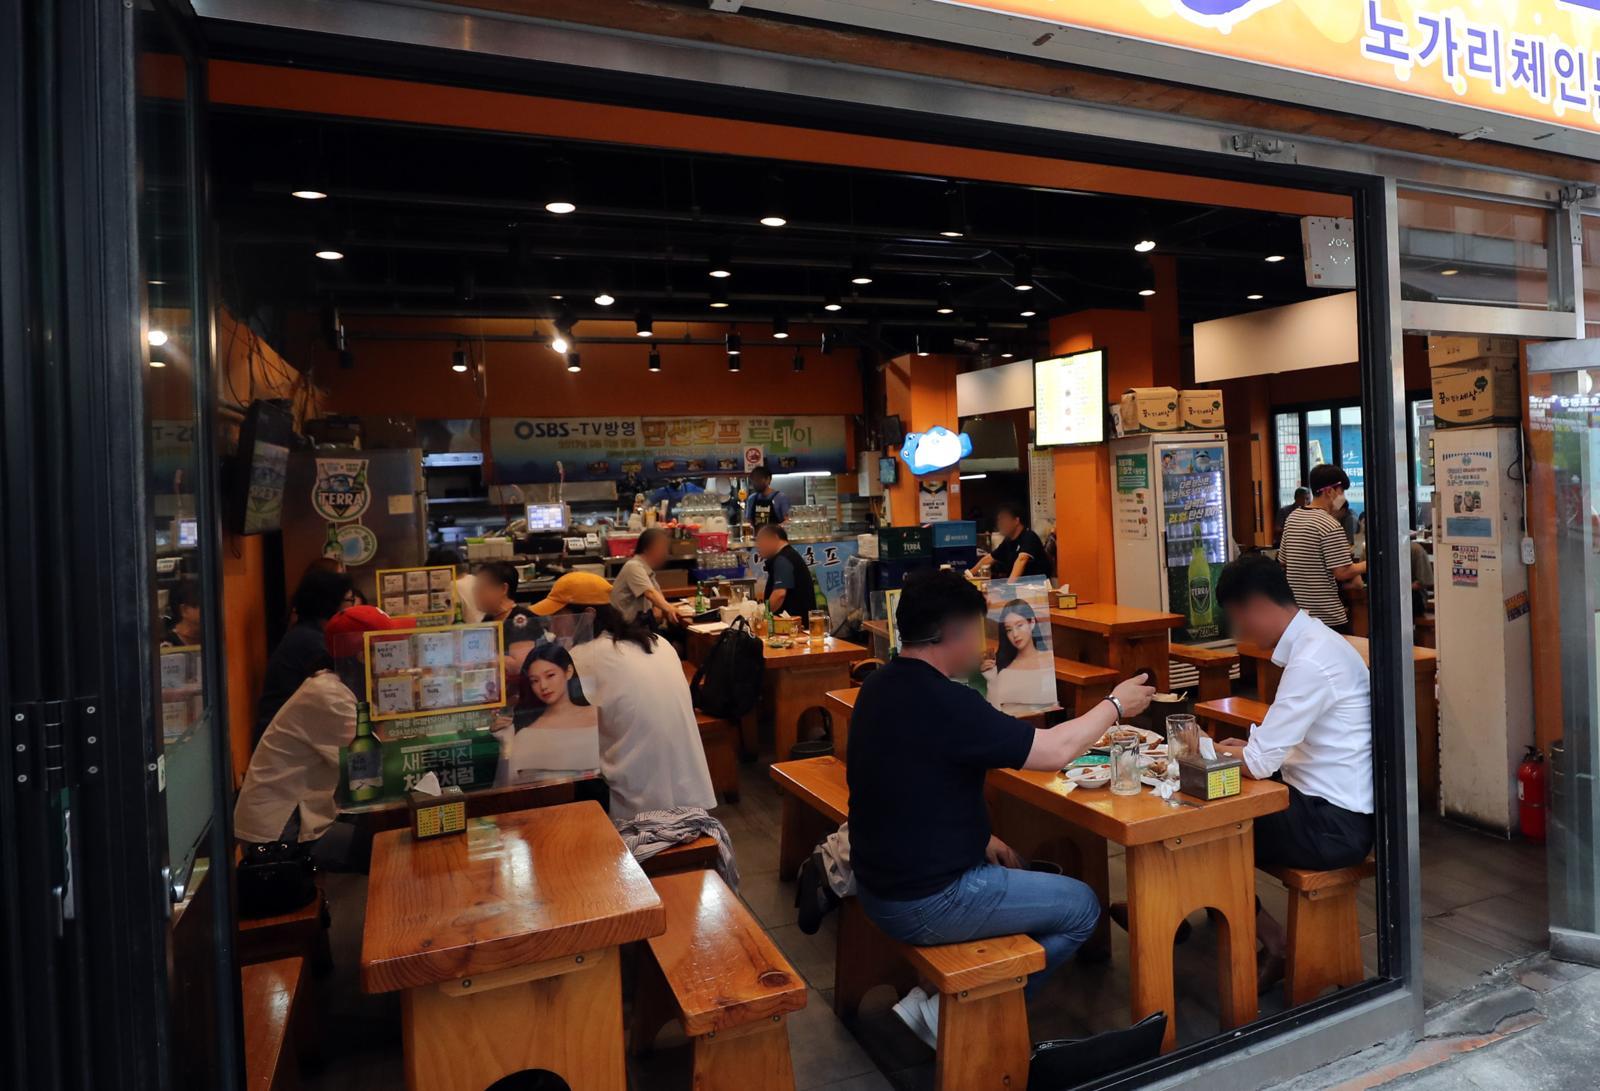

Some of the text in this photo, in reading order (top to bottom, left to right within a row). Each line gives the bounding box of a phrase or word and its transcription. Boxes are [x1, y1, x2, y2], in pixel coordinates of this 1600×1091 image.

[1365, 1, 1600, 105] 노가리체인
[318, 492, 363, 506] TERRA
[903, 542, 921, 552] TERRA
[402, 747, 474, 772] 새로워진
[403, 767, 475, 792] 처처럼
